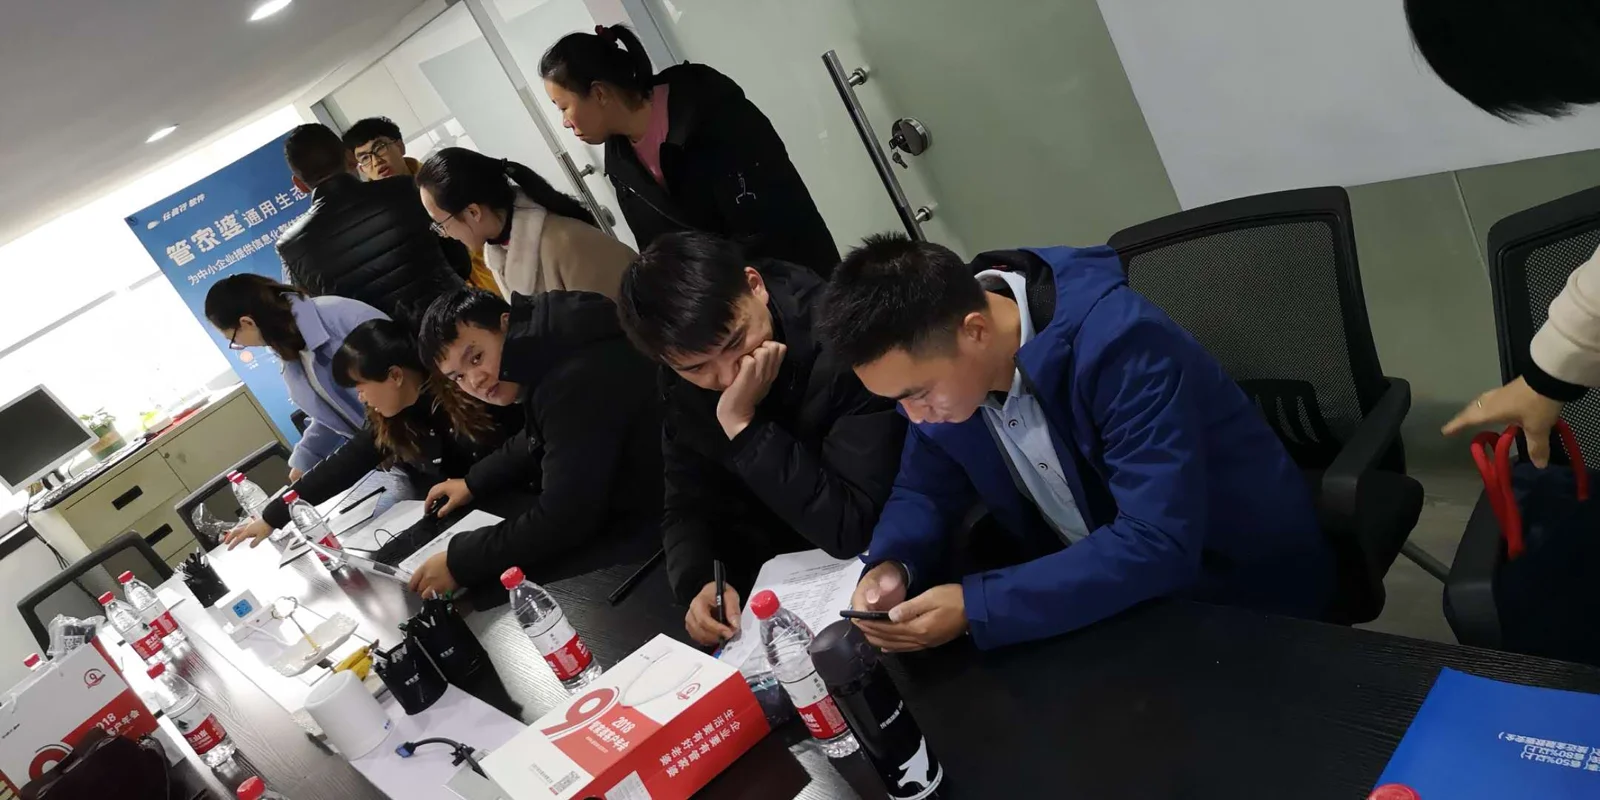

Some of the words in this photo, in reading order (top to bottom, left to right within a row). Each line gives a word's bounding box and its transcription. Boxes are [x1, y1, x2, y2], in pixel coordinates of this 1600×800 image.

[166, 213, 245, 267] 管家婆
[95, 713, 117, 731] 018
[611, 716, 636, 734] 2018
[659, 708, 735, 766] 生活要有好老婆
[666, 720, 741, 778] 企业要有管家婆
